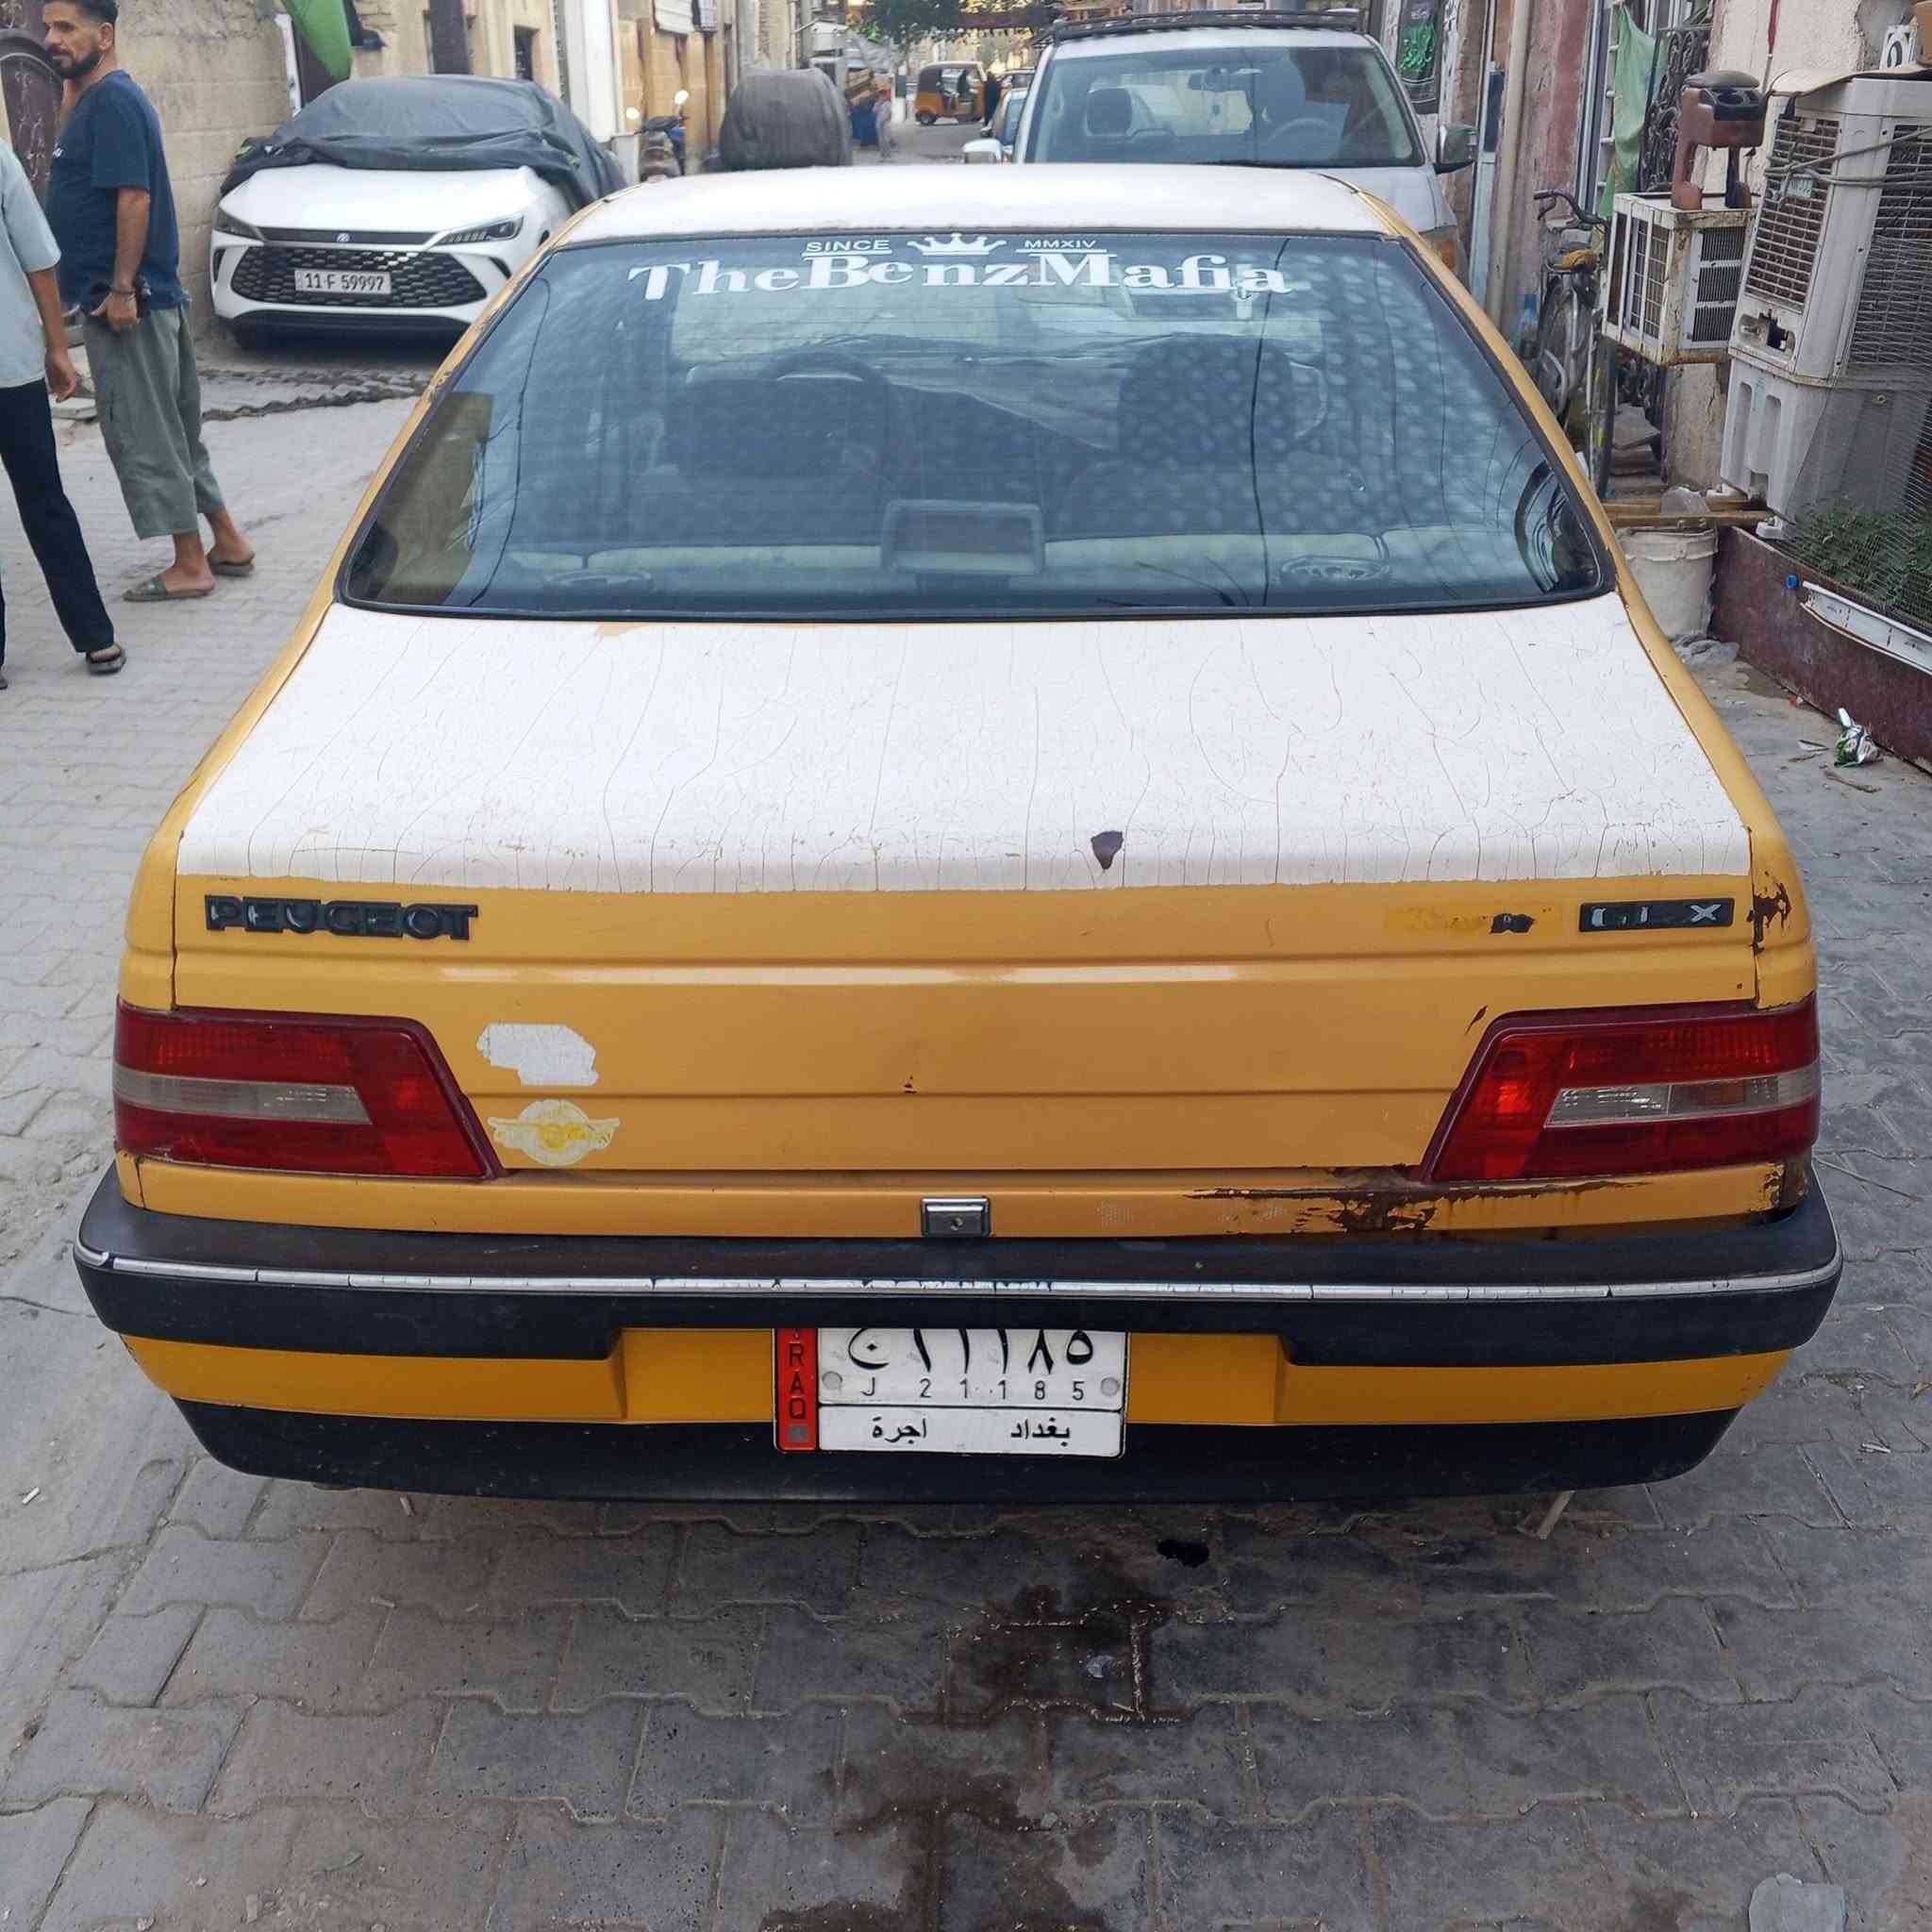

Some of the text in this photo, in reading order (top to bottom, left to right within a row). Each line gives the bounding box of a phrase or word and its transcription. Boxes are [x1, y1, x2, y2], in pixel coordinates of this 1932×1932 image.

[806, 240, 891, 252] SINCE
[1024, 240, 1095, 248] MMXIV
[305, 273, 322, 289] 11
[341, 275, 385, 291] 59997
[627, 253, 1292, 302] TheBenzMafia
[205, 894, 478, 941] PEUGEOT
[789, 1328, 807, 1420] RAQ
[860, 1377, 1085, 1402] J 21185
[1010, 1418, 1072, 1447] بغداد
